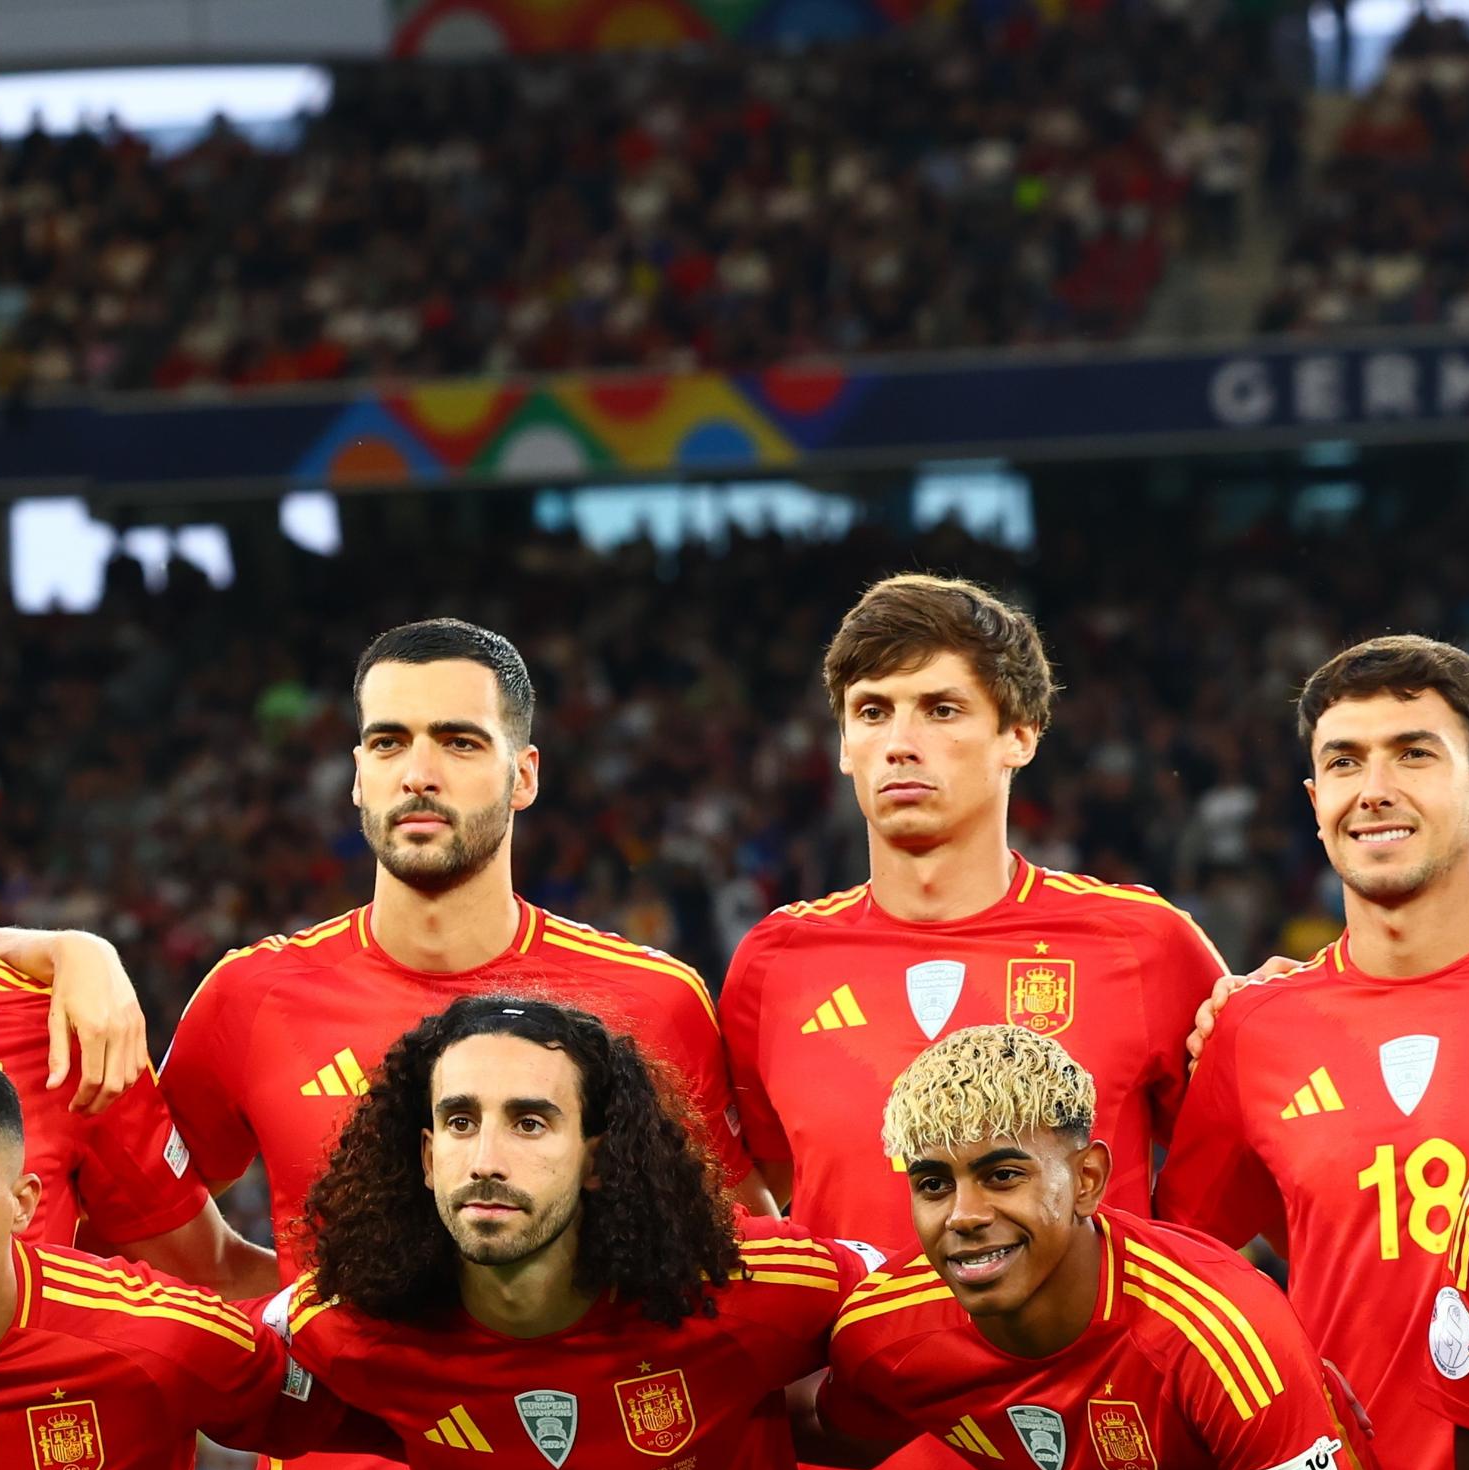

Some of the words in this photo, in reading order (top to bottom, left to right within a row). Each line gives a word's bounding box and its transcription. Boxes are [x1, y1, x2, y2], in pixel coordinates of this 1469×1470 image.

[1358, 1138, 1467, 1260] 18
[521, 1401, 571, 1410] EUROPEAN
[523, 1409, 572, 1417] CHAMPIONS
[540, 1440, 566, 1449] 2024
